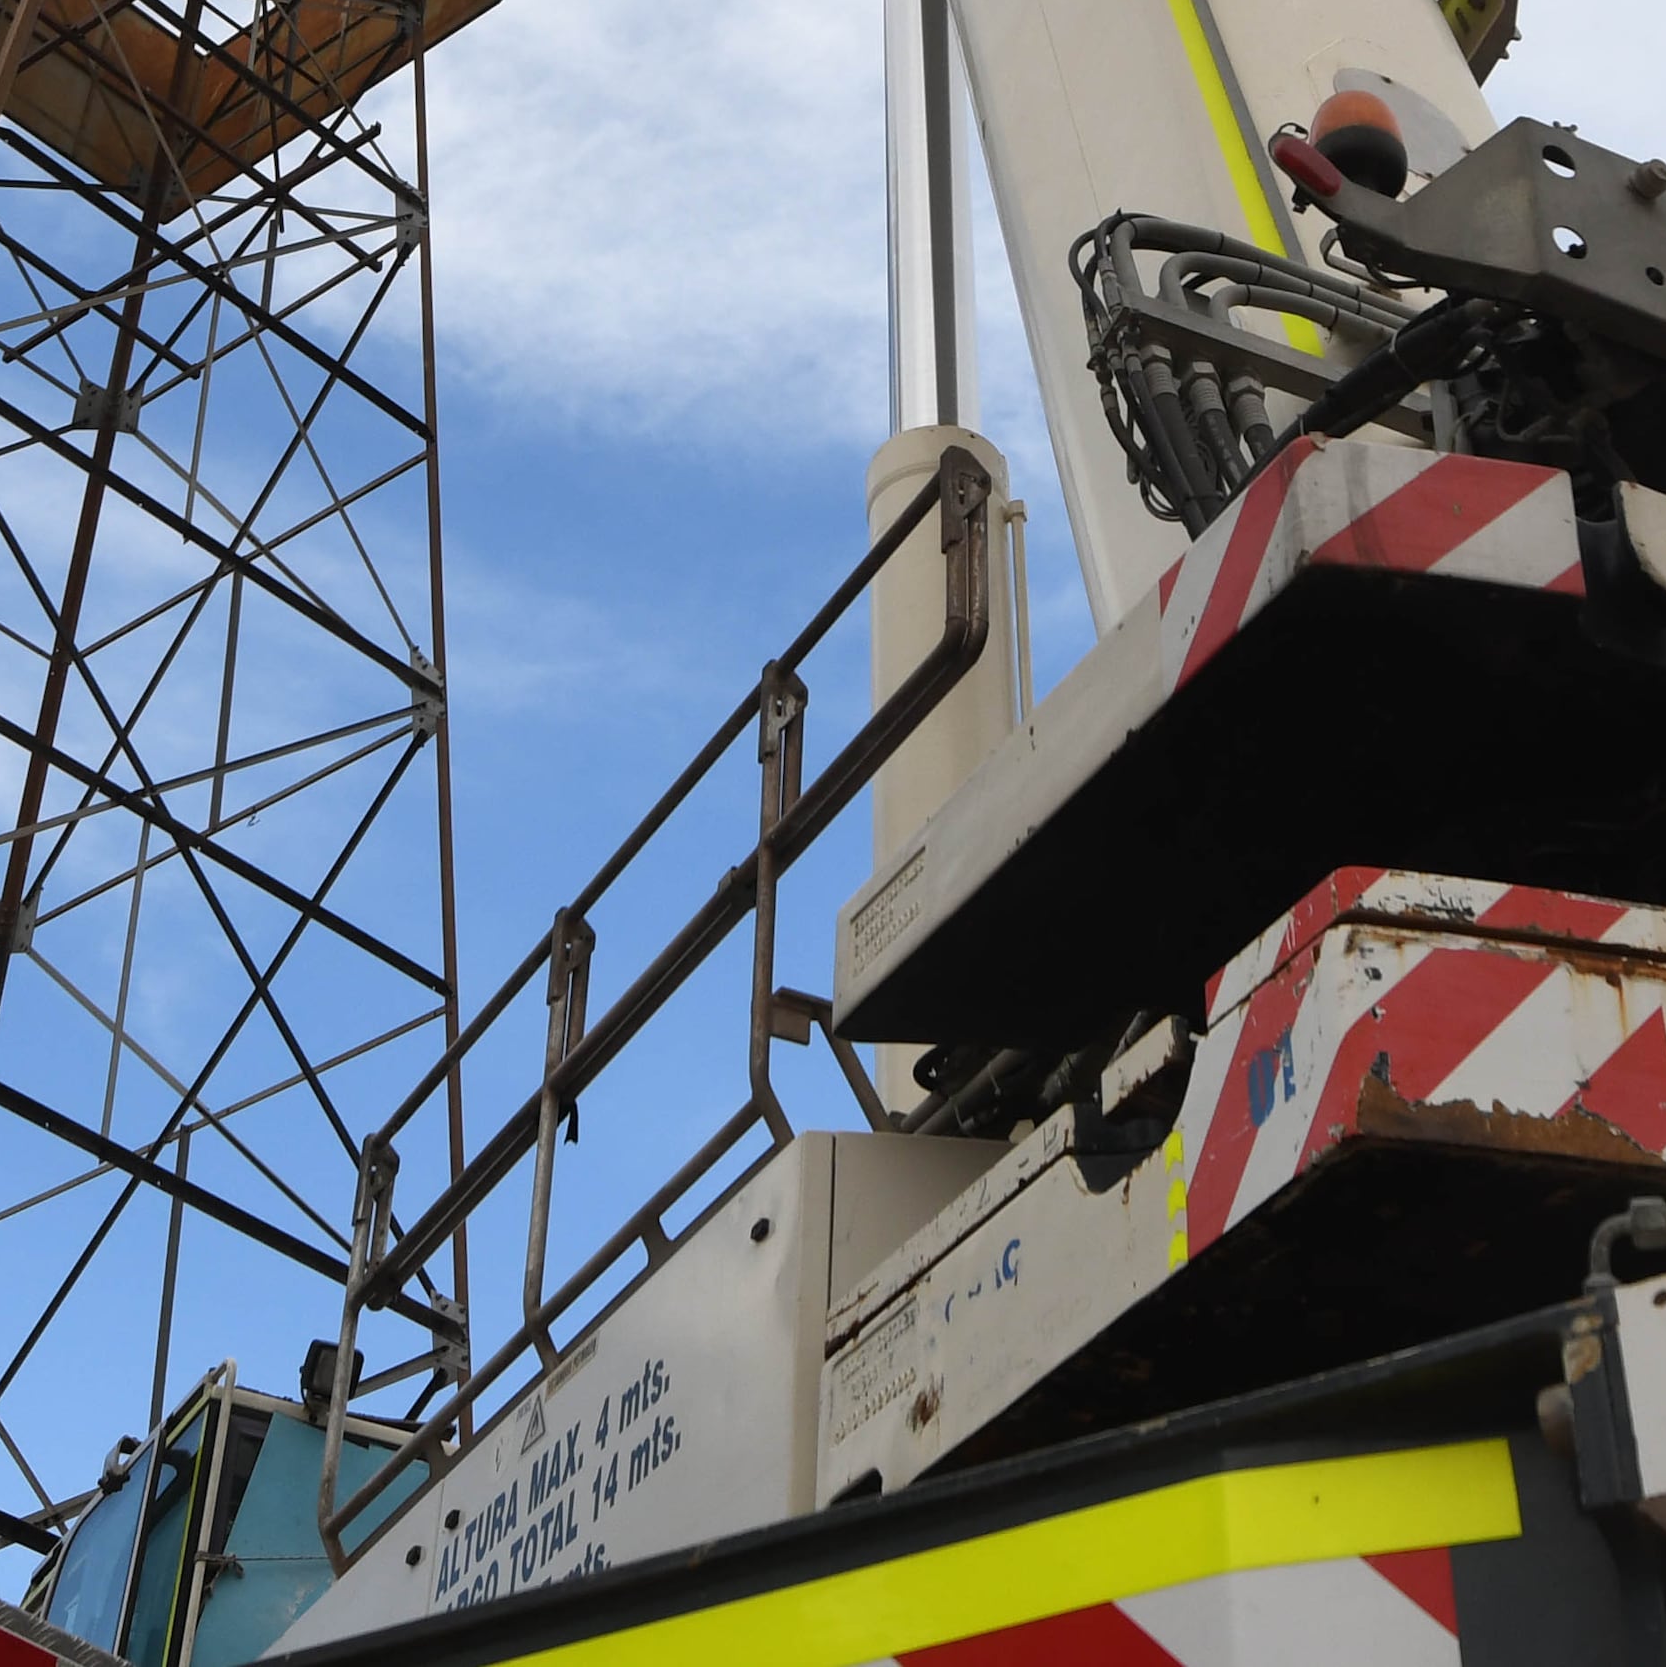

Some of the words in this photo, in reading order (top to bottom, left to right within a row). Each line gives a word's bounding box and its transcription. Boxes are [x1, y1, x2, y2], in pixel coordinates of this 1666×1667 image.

[435, 1479, 518, 1602] ALTURA
[527, 1420, 584, 1515] MAX.
[594, 1395, 610, 1449] 4
[619, 1358, 670, 1434] mts.
[510, 1490, 578, 1592] TOTAL
[592, 1452, 619, 1523] 14
[628, 1415, 682, 1492] mts.
